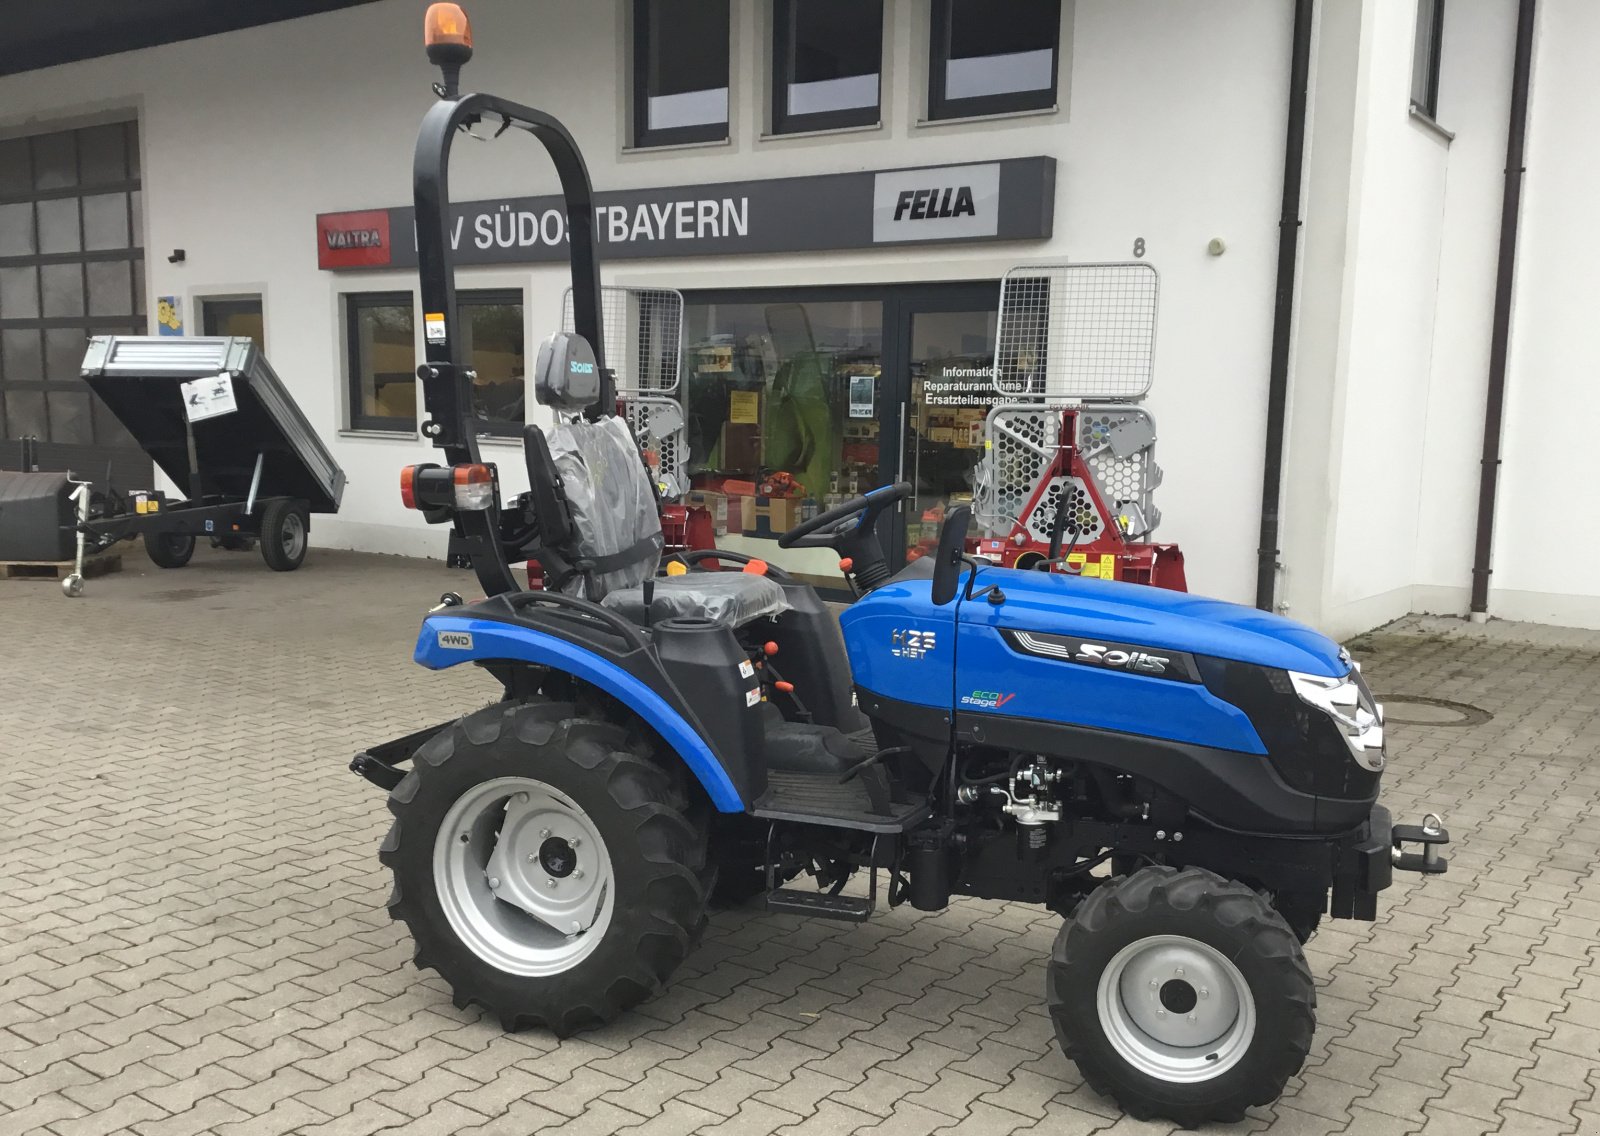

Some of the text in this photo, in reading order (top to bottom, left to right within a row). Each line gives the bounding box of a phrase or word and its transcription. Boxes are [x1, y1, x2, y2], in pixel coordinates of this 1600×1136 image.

[893, 186, 976, 221] FELLA
[326, 228, 382, 249] VALTRA
[1132, 237, 1146, 258] 8
[441, 635, 470, 646] 4WD
